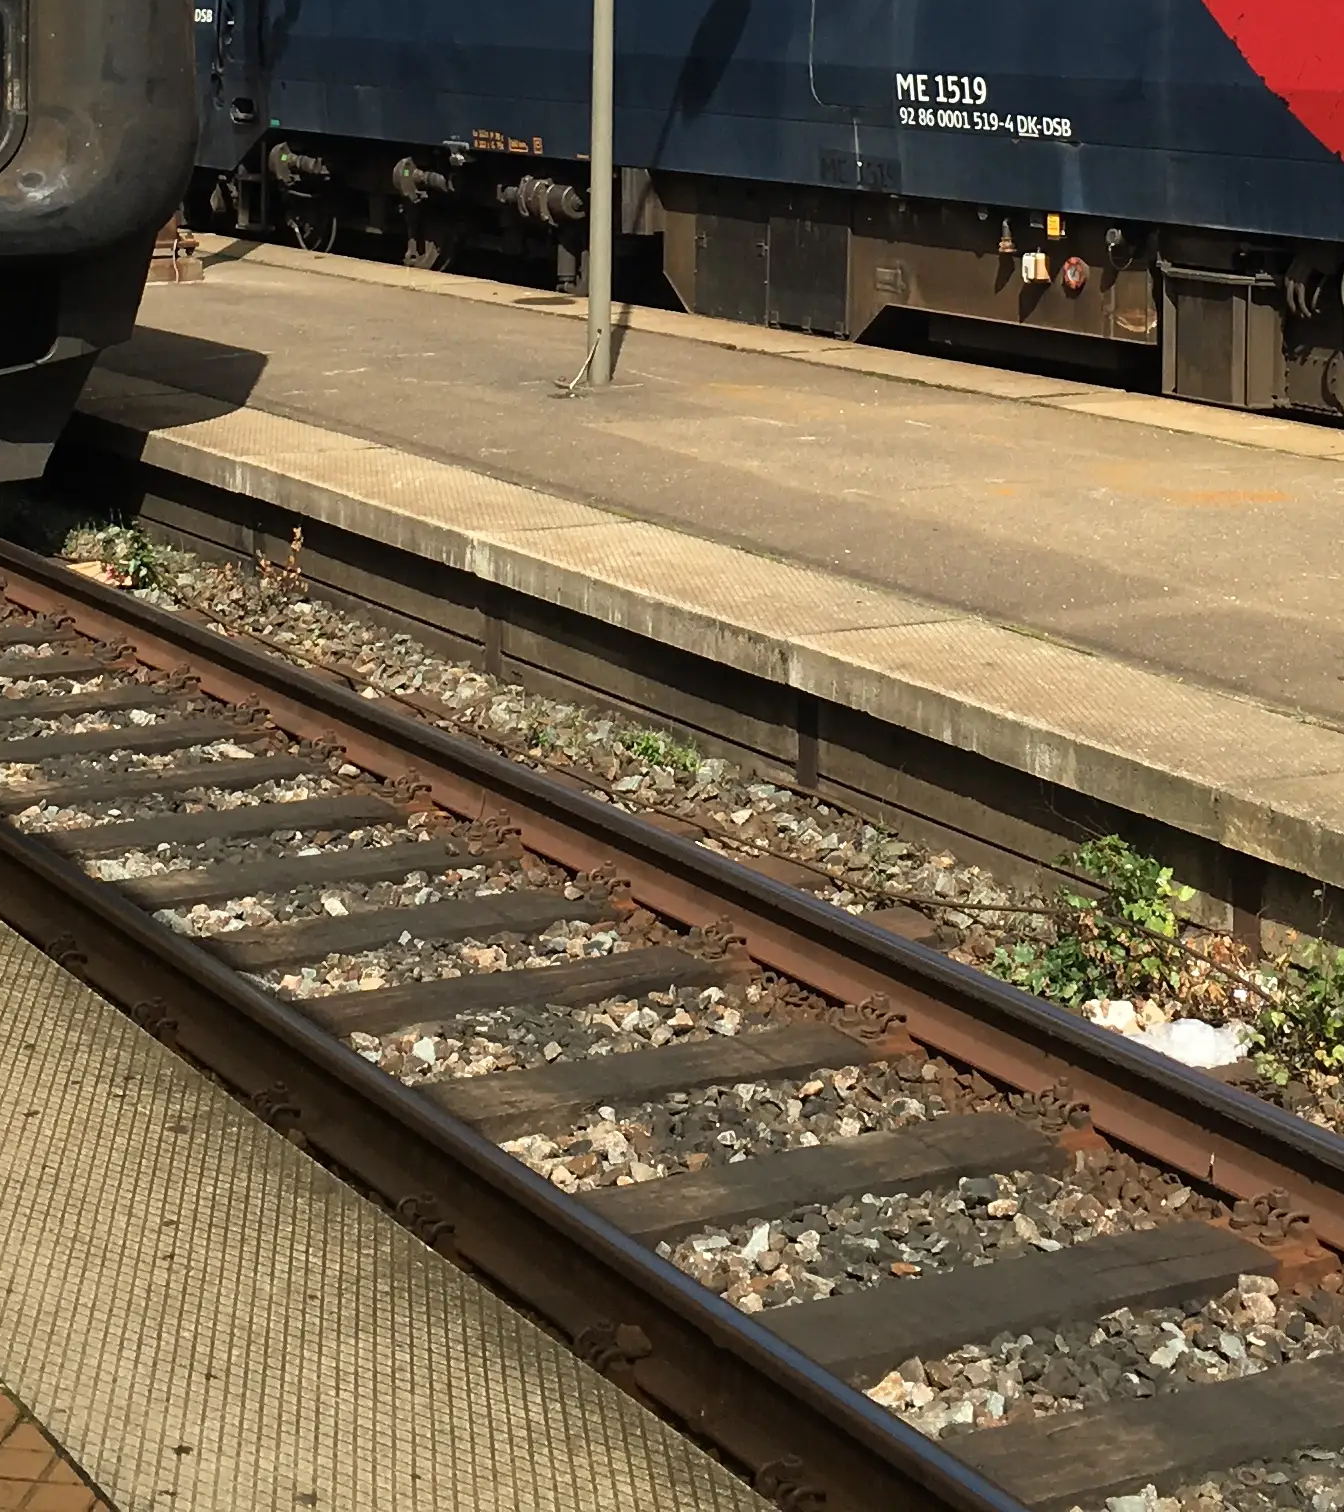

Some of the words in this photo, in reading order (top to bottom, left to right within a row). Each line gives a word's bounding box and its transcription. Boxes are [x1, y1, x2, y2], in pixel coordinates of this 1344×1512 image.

[194, 8, 213, 23] DSB
[896, 73, 930, 102] ME
[934, 74, 988, 105] 1519
[899, 106, 916, 125] 92
[918, 108, 935, 127] 86
[937, 109, 971, 129] 0001
[974, 111, 1014, 133] 519-4
[1016, 114, 1072, 137] DK-DSB
